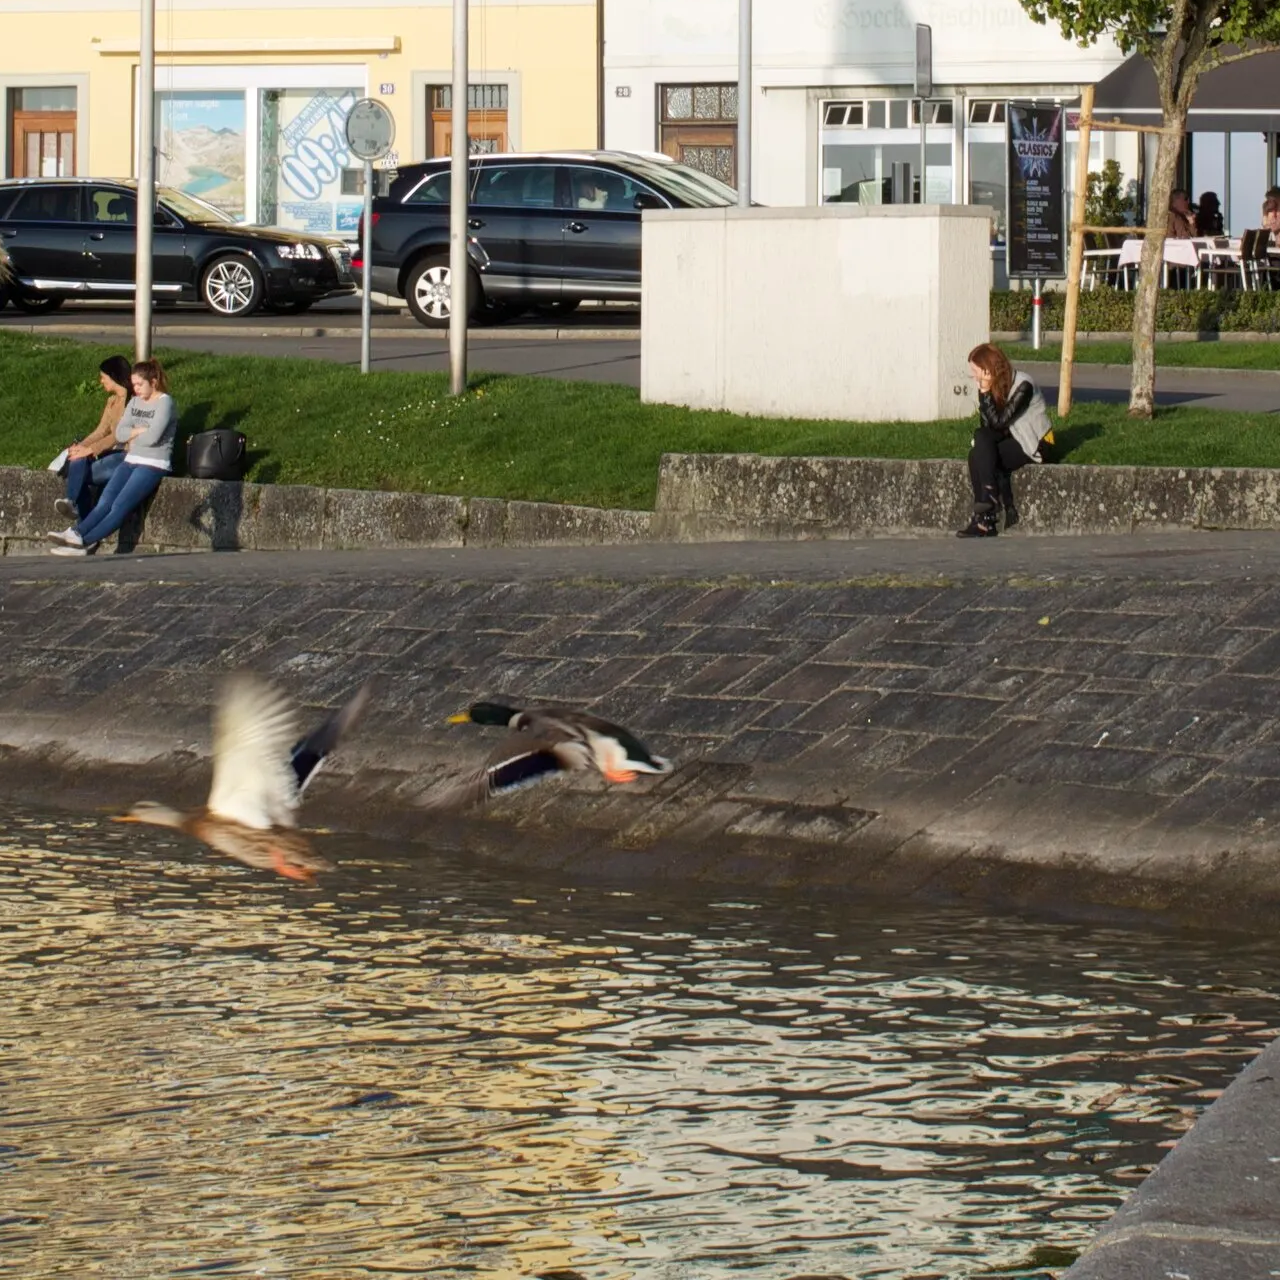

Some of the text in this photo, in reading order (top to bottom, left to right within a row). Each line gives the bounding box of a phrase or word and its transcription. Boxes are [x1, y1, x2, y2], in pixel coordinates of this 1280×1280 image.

[382, 84, 393, 93] 30
[617, 87, 629, 96] 28
[1018, 143, 1053, 156] CLASSICS
